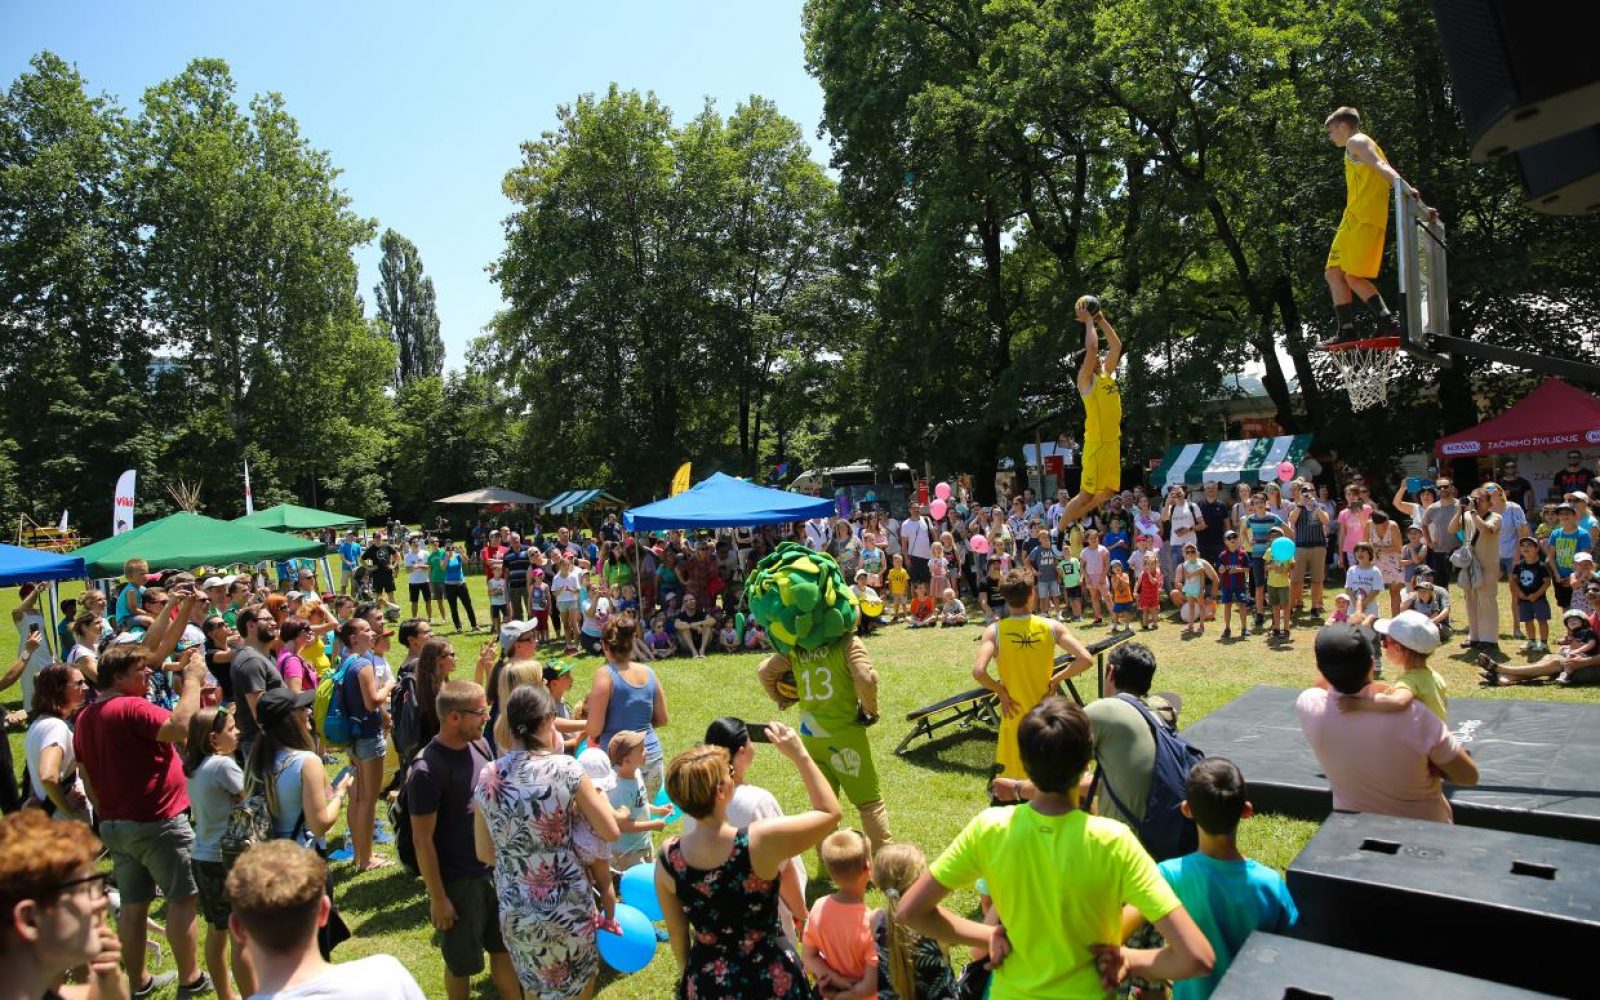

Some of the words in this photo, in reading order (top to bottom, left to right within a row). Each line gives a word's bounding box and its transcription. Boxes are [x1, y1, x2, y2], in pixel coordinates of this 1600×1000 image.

[1487, 438, 1531, 449] ZAČINIMO
[1532, 434, 1579, 446] ŽIVLJENJE
[802, 666, 834, 701] 13
